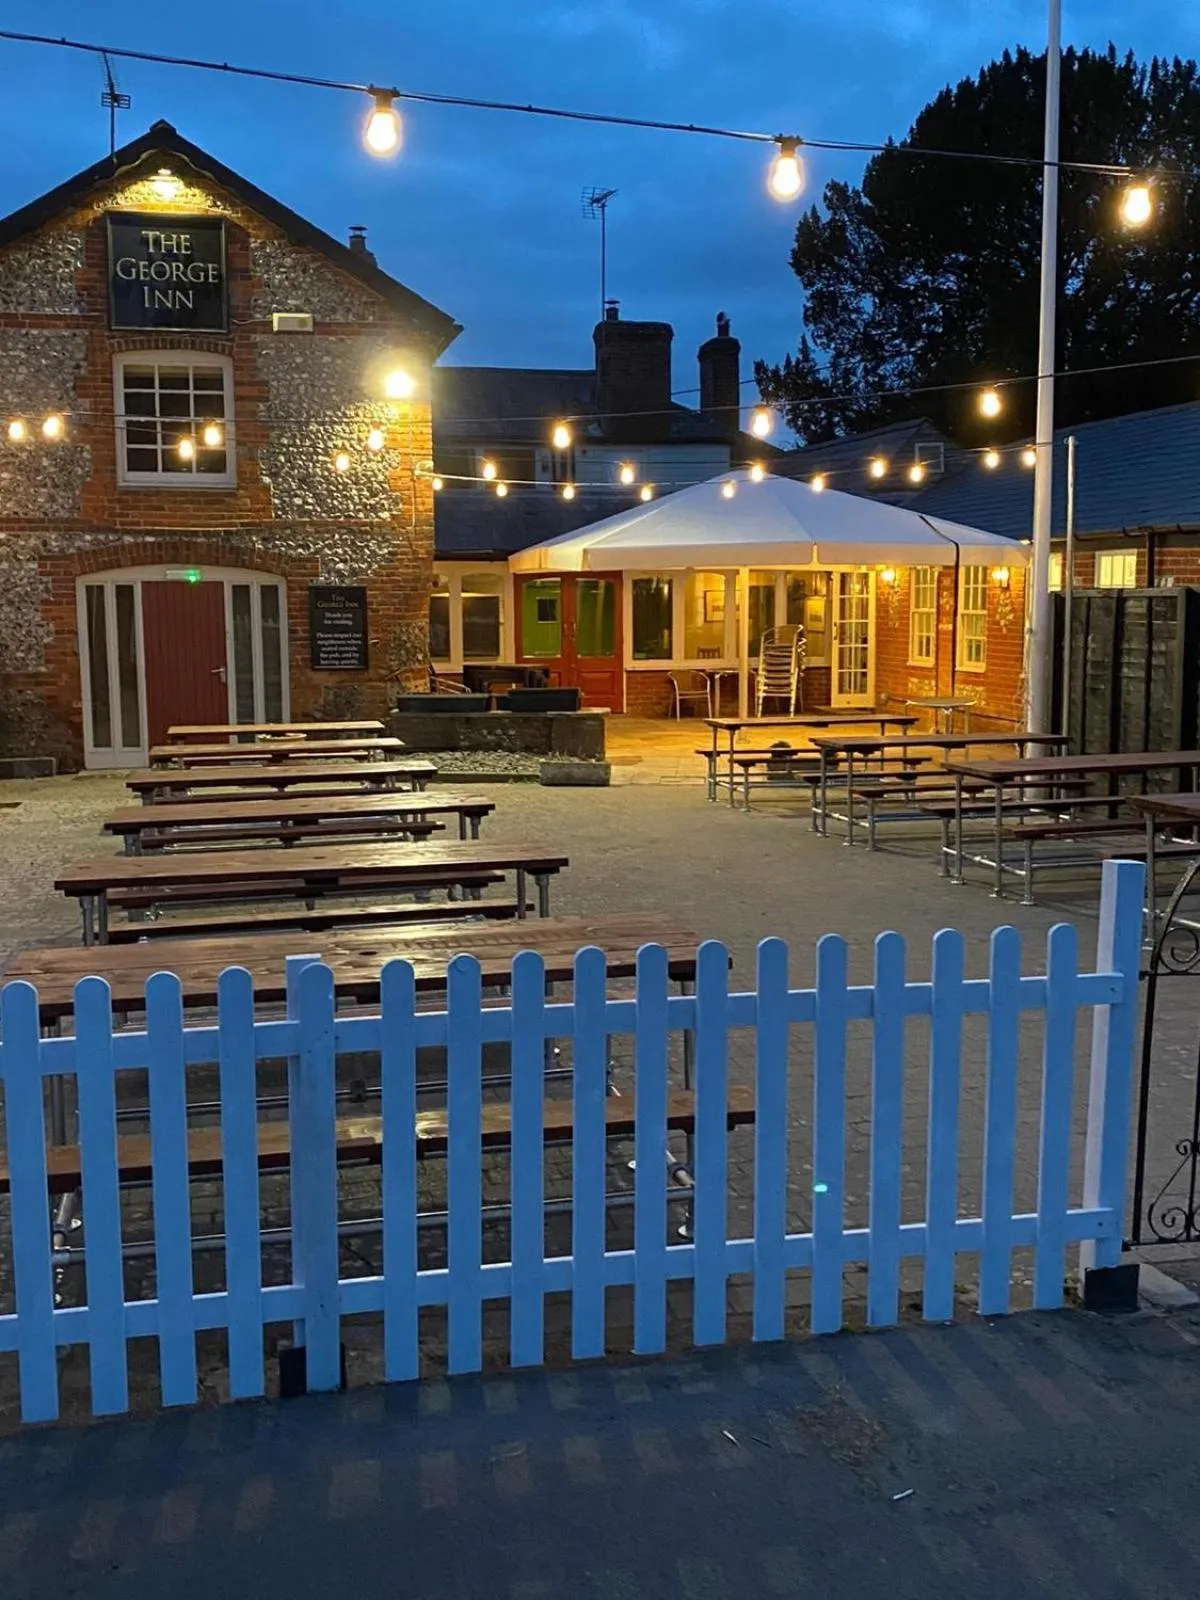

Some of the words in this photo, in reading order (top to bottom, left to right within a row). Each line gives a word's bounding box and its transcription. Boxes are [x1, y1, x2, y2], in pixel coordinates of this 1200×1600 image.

[141, 230, 192, 254] THE
[116, 257, 219, 283] GEORGE
[143, 286, 193, 309] INN
